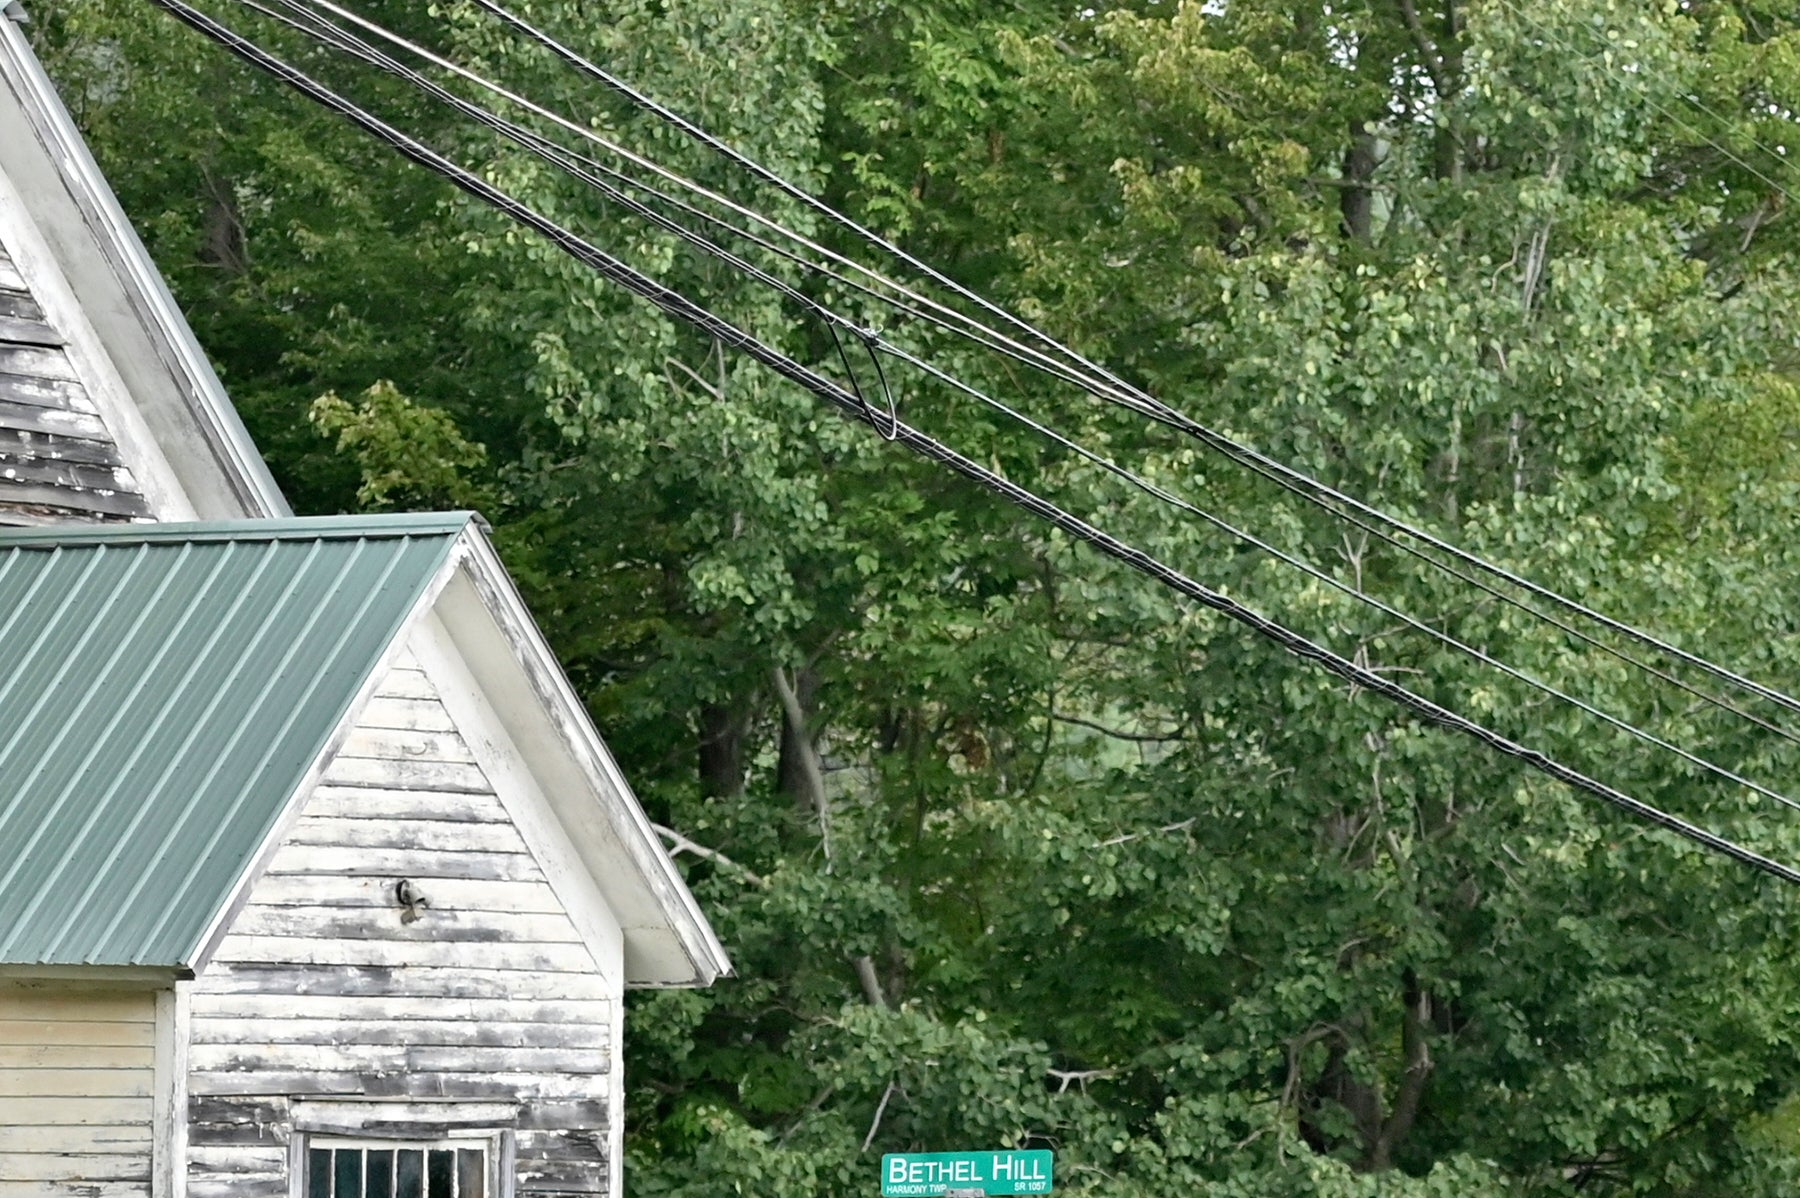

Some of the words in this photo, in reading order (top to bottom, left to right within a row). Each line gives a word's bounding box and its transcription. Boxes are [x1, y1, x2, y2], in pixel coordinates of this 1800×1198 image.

[889, 1158, 983, 1183] BETHEL
[992, 1154, 1046, 1181] HILL
[886, 1184, 927, 1195] HARMONY
[929, 1184, 947, 1193] TWP
[1014, 1182, 1026, 1192] SR
